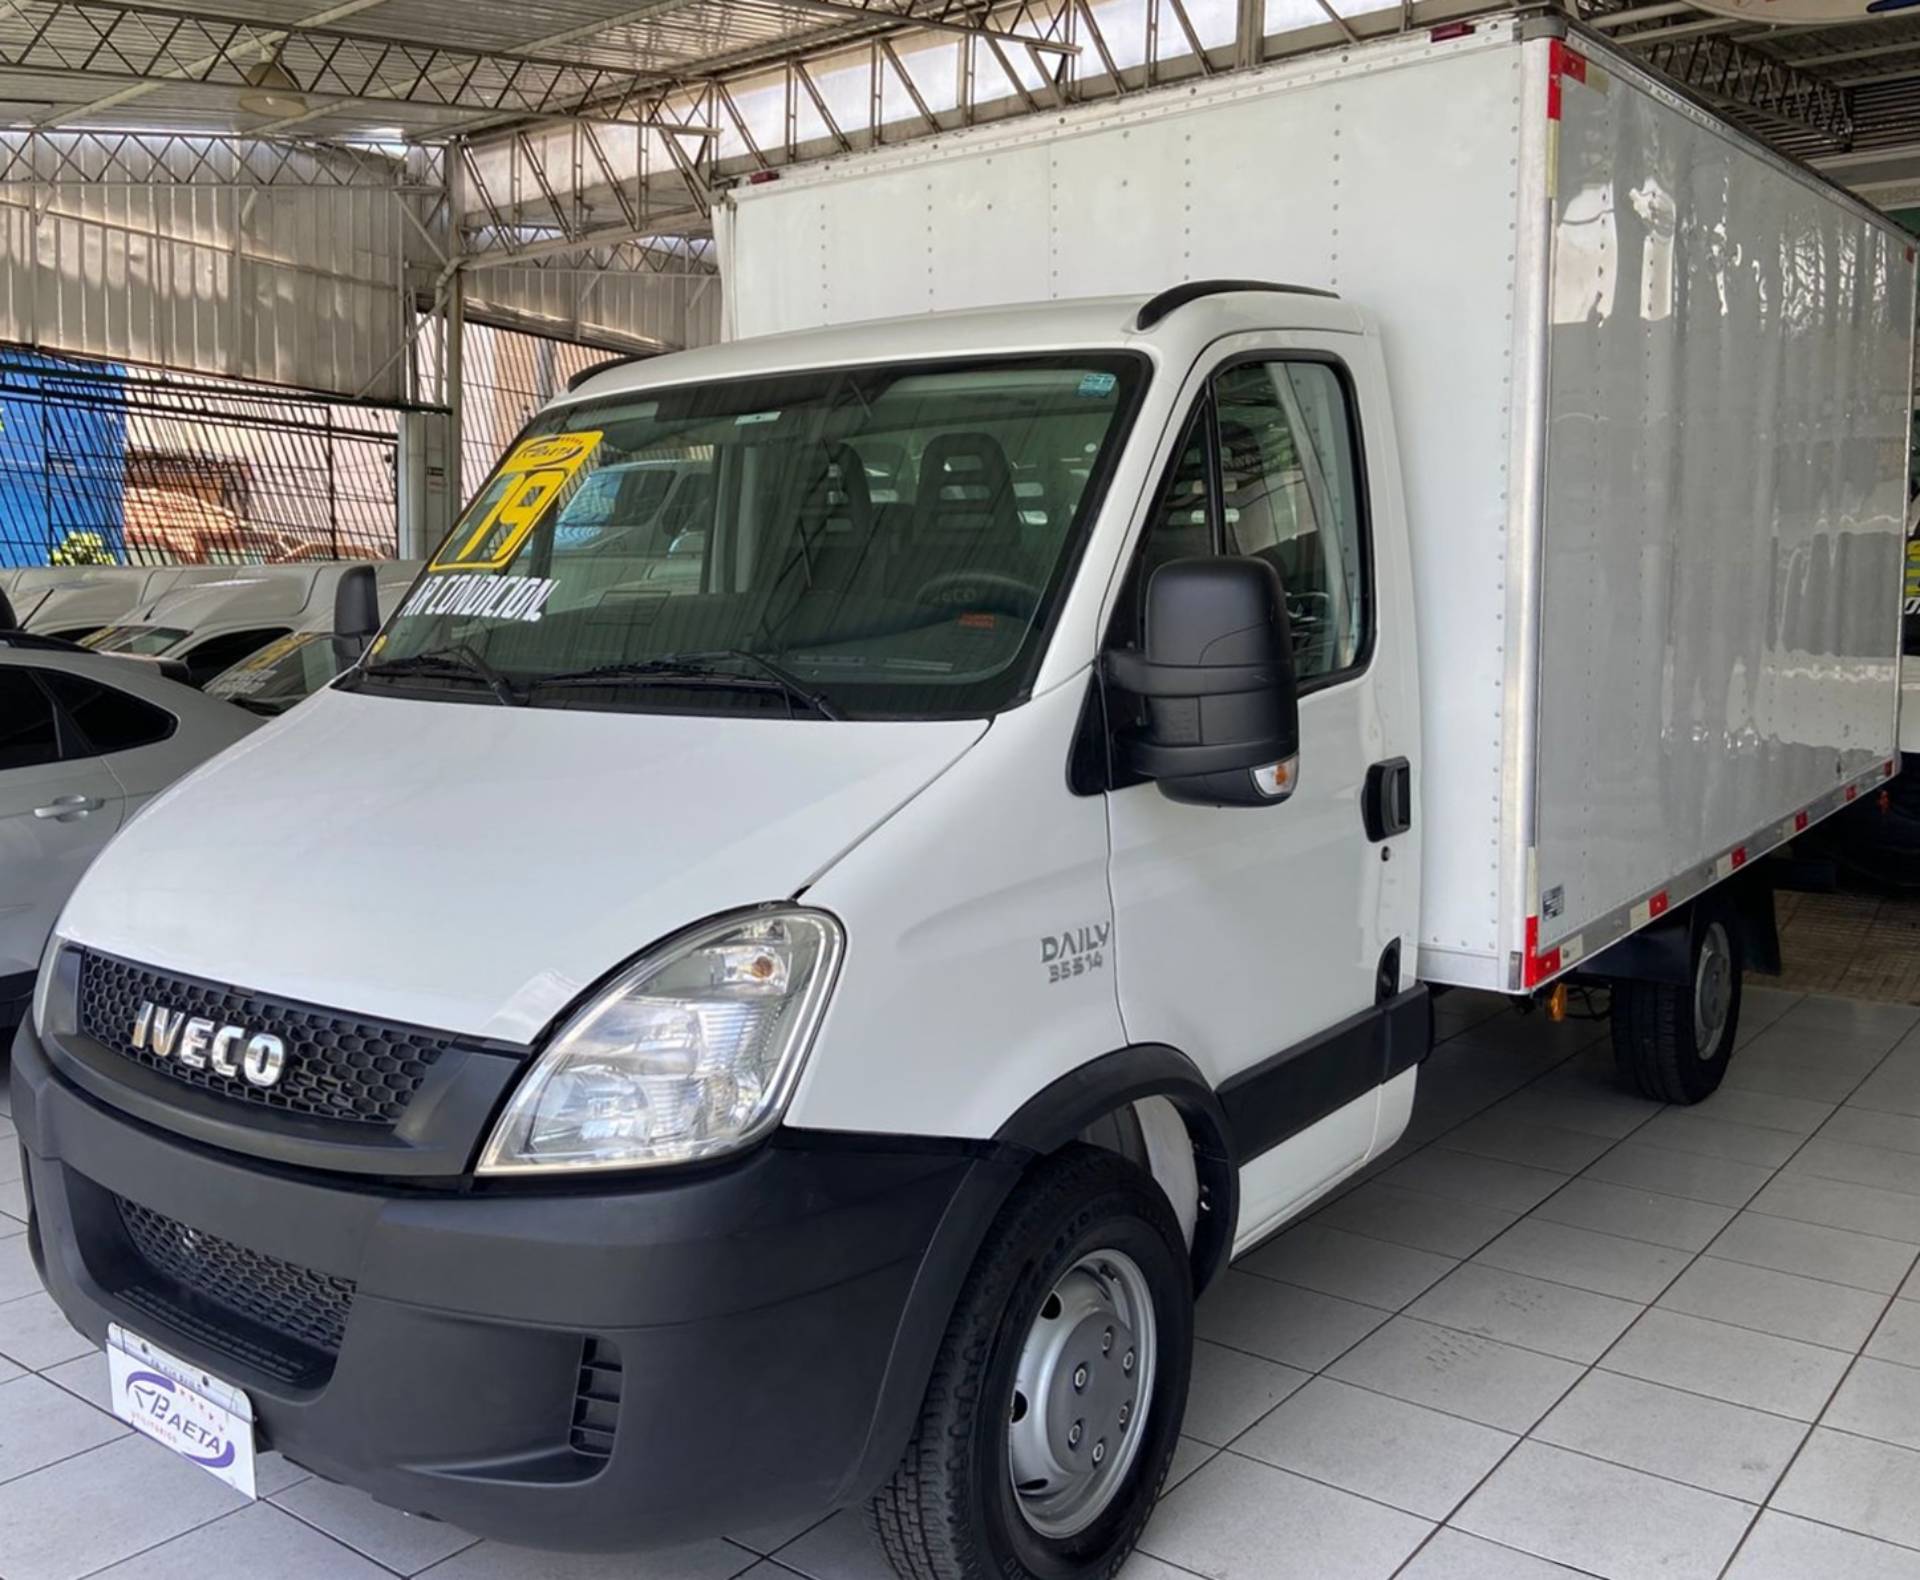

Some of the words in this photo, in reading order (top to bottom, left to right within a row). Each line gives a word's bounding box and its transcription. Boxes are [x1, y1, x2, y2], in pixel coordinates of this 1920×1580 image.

[456, 469, 566, 562] 19
[397, 575, 444, 618] AR
[1041, 921, 1110, 963] DAILY
[131, 1000, 285, 1087] IVECO
